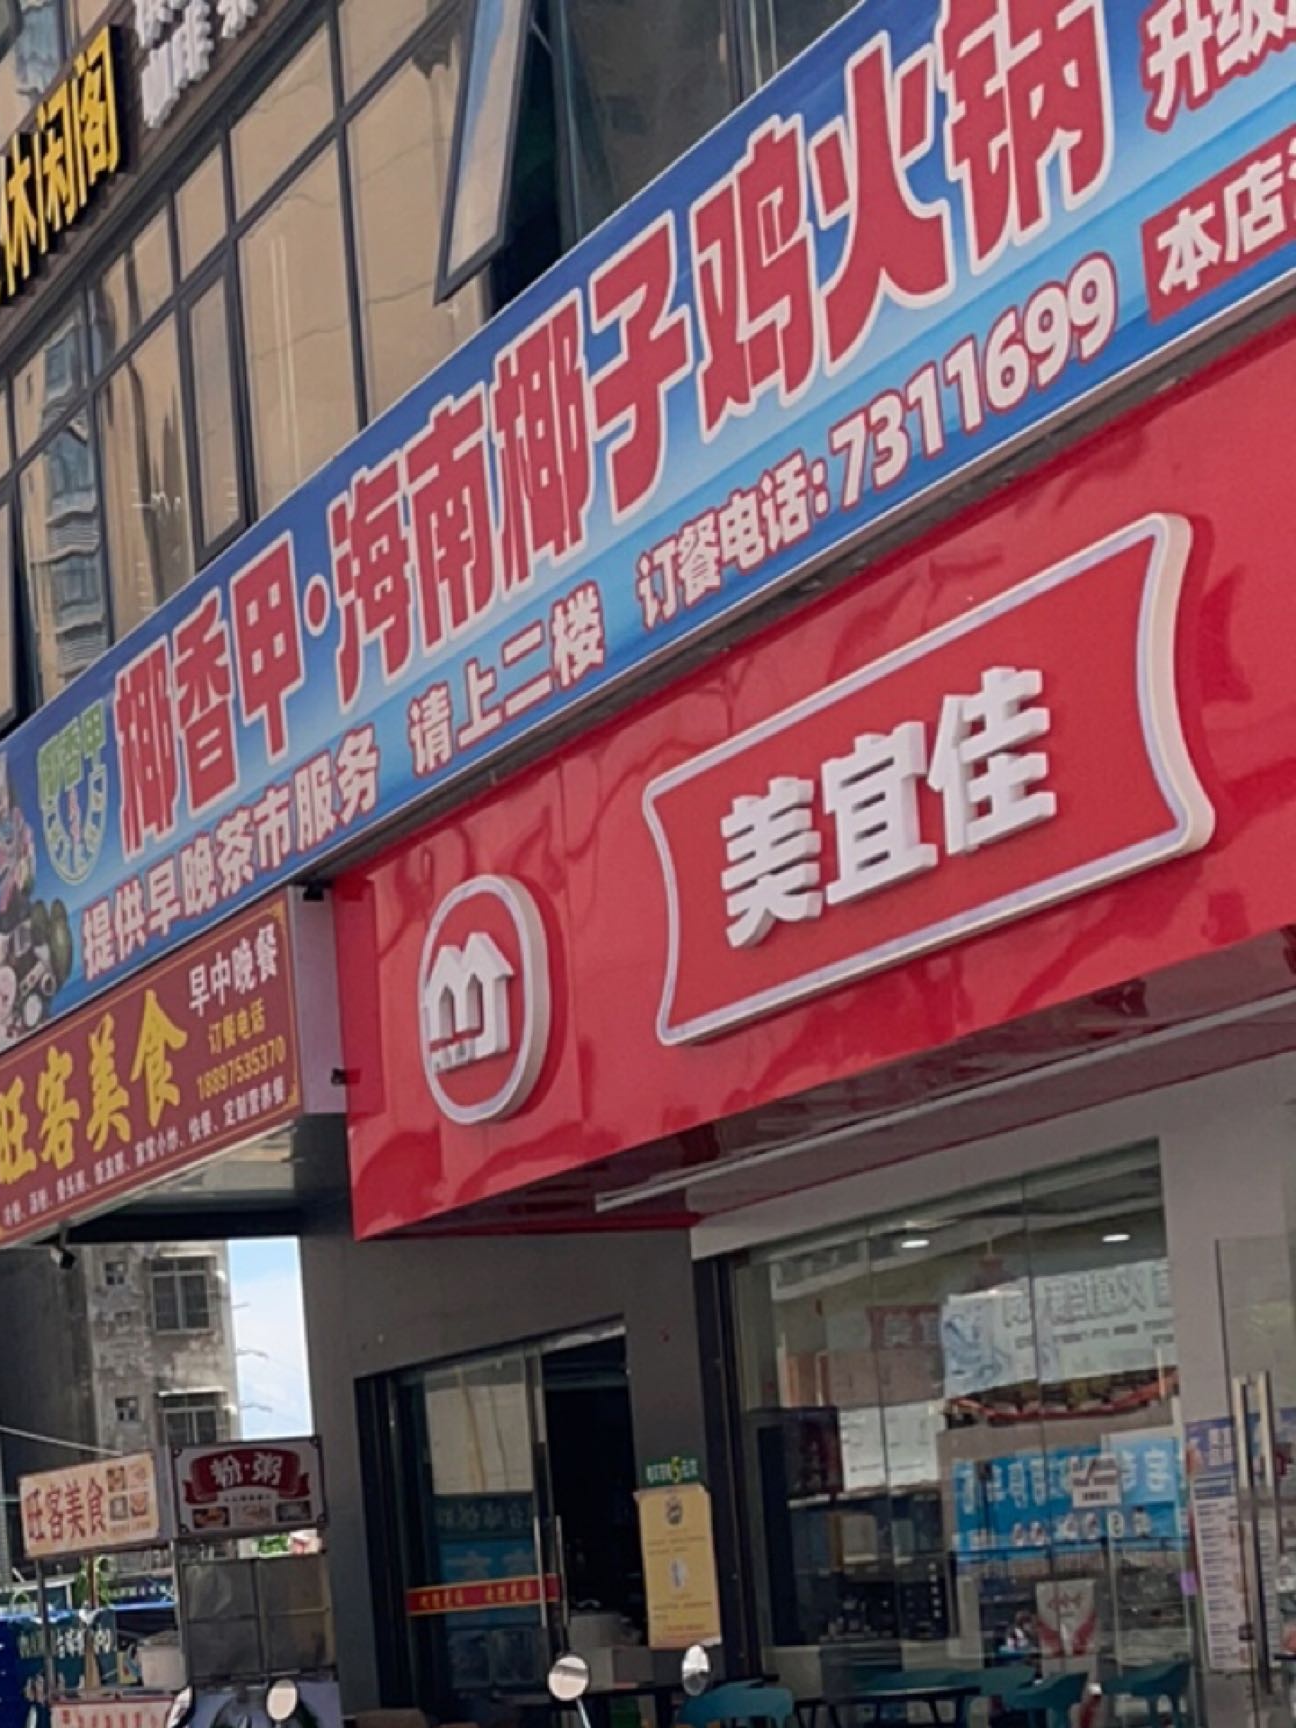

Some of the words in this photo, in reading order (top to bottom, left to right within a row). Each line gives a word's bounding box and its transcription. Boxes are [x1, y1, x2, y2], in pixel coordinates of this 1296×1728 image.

[1156, 135, 1296, 295] 本店
[81, 724, 381, 982] 提供早晚茶市服务
[408, 582, 605, 777] 请上二楼
[721, 666, 1056, 948] 美宜佳
[188, 922, 279, 1018] 早中晚餐
